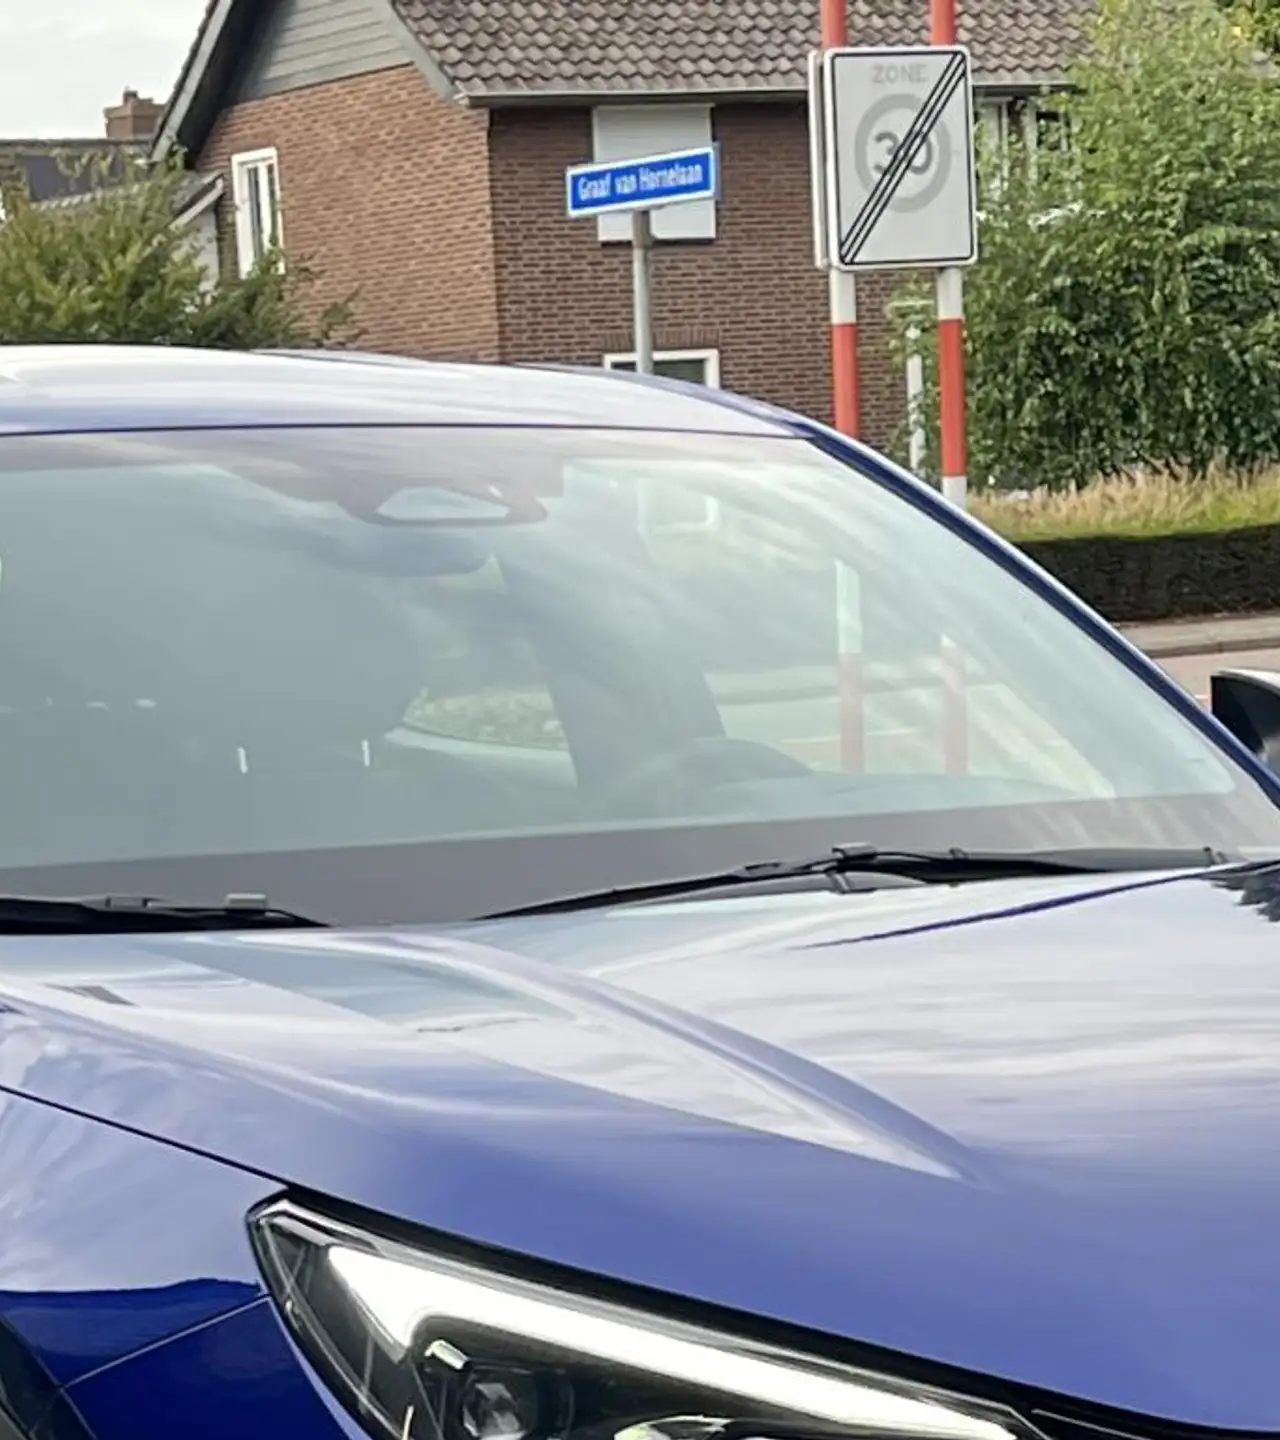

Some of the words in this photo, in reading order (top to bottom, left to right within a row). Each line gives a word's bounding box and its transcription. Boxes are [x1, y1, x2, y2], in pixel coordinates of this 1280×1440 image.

[871, 64, 928, 84] ZONE
[874, 131, 933, 175] 30
[577, 172, 612, 201] Graaf
[615, 173, 637, 195] van
